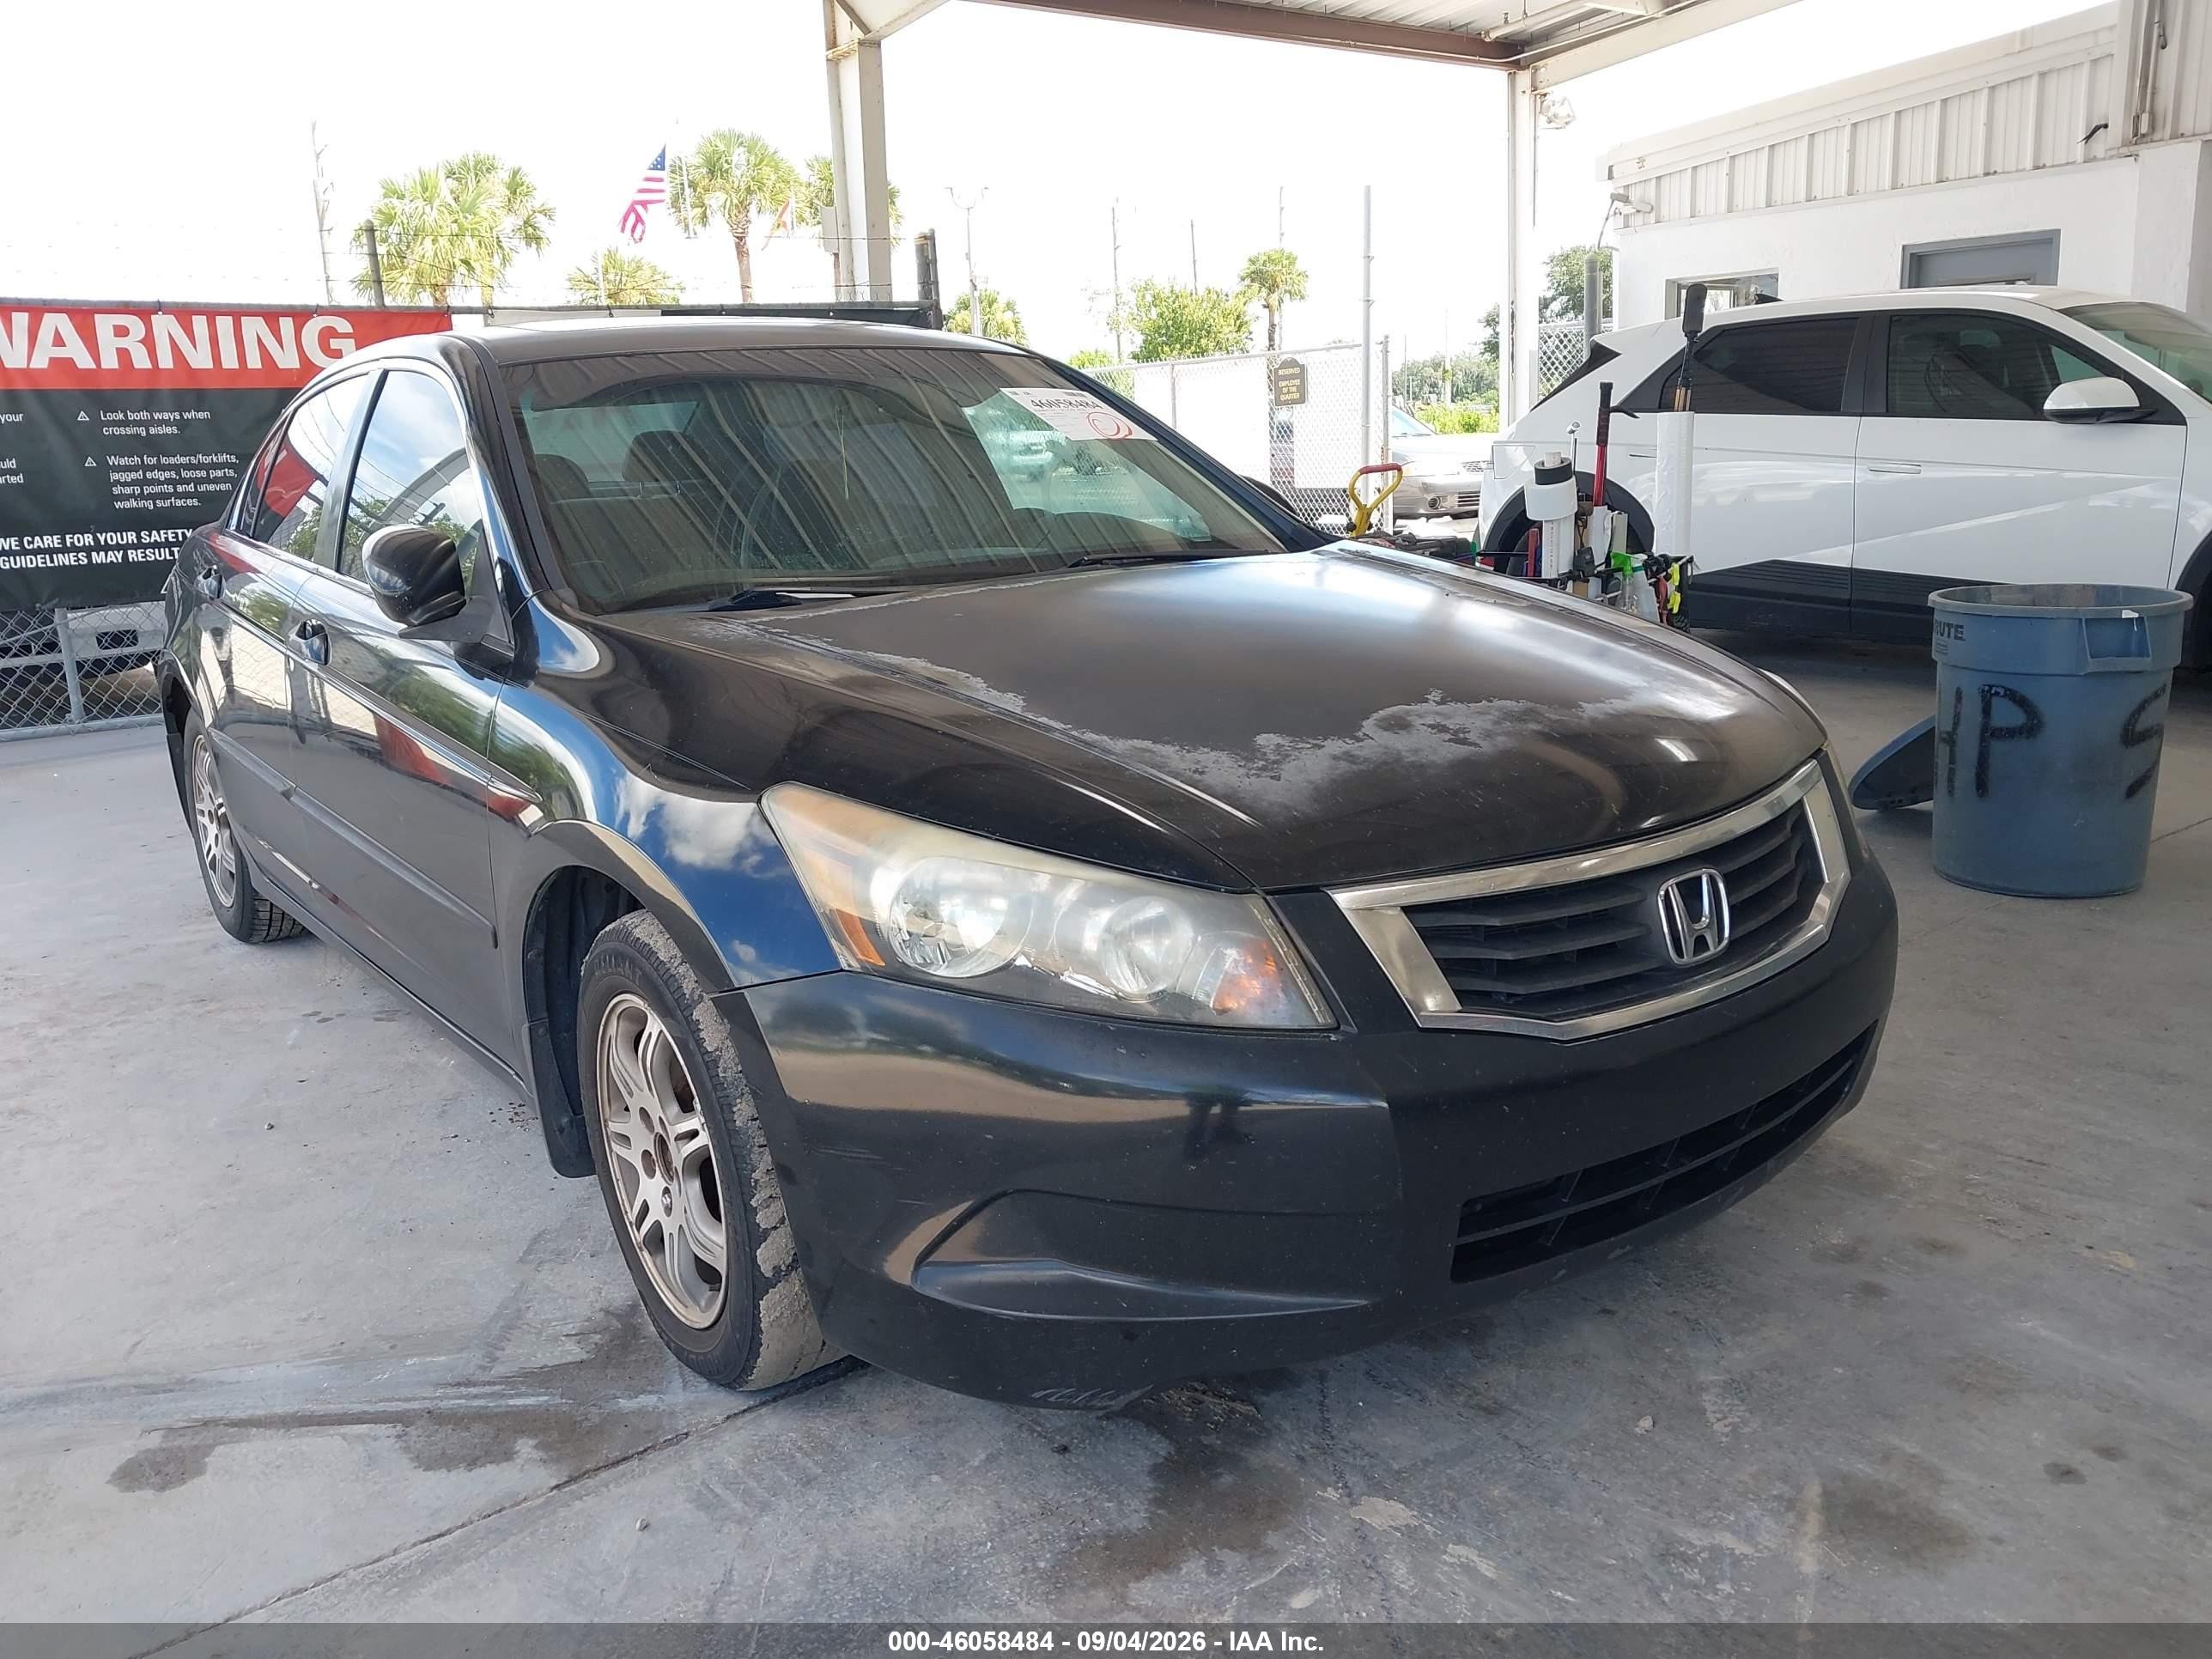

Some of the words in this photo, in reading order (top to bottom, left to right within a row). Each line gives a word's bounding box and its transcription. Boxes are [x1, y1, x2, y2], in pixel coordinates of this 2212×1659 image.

[1278, 367, 1301, 376] RESERVED
[1279, 379, 1301, 387] EMPLOYEE
[1279, 392, 1300, 401] QUARTER
[0, 413, 24, 424] your
[100, 410, 125, 421] Look
[127, 410, 150, 421] both
[153, 410, 180, 422] ways
[182, 410, 211, 420] when
[103, 424, 146, 436] crossing
[149, 424, 181, 434] aisles.
[106, 454, 141, 466] Watch
[143, 454, 159, 465] for
[160, 453, 240, 465] loaders/forklifts,
[109, 469, 145, 483] jagged
[146, 469, 179, 481] edges,
[180, 468, 207, 478] loose
[210, 468, 238, 479] parts,
[112, 483, 141, 495] sharp
[143, 483, 173, 495] points
[176, 483, 195, 493] and
[197, 483, 233, 493] uneven
[114, 499, 154, 511] walking
[155, 497, 202, 508] surfaces.
[23, 535, 62, 550] CARE
[66, 533, 94, 548] FOR
[96, 531, 137, 546] YOUR
[141, 528, 193, 544] SAFETY
[0, 551, 87, 569] GUIDELINES
[92, 550, 124, 565] MAY
[128, 547, 180, 562] RESULT
